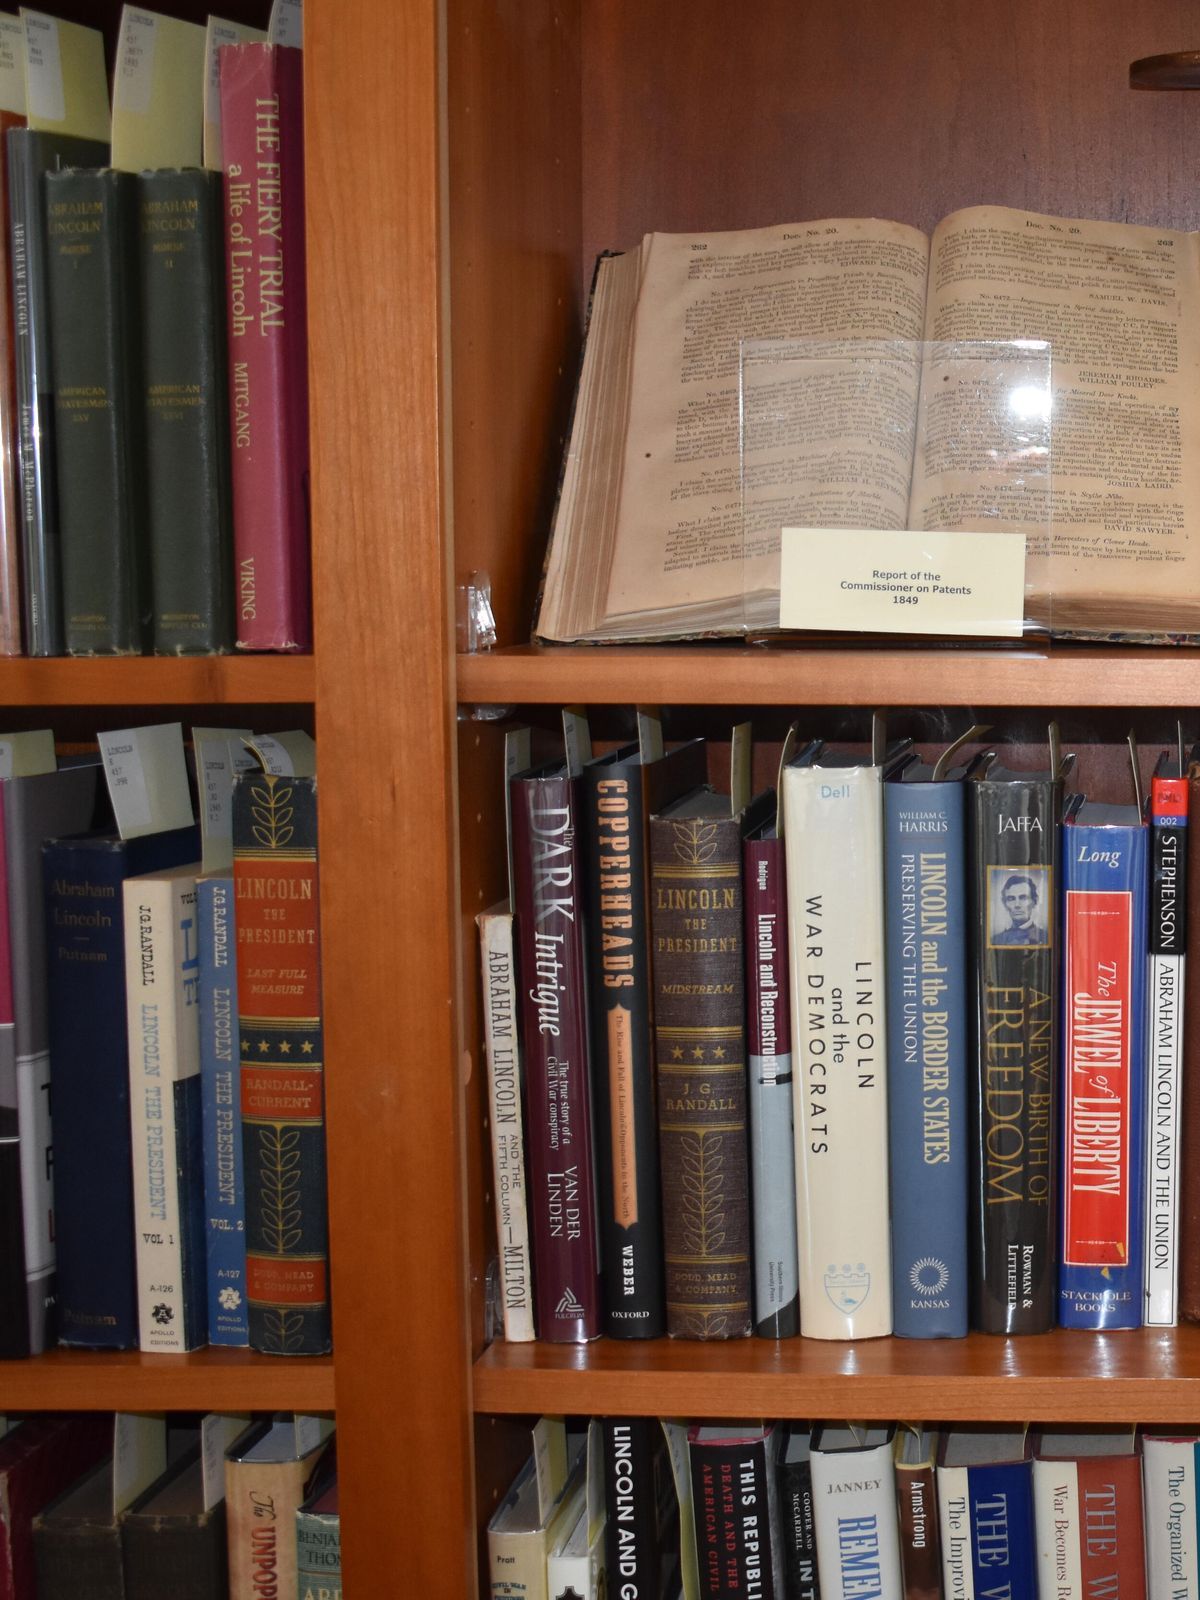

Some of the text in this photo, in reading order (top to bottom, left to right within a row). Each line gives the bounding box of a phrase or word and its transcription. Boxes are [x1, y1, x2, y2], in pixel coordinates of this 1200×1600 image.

[255, 94, 285, 337] THE FIERY TRIAL
[229, 164, 254, 337] a life of Lincoln
[234, 362, 251, 449] MITGANG
[240, 557, 256, 621] VIKING
[840, 580, 972, 595] Commissioner on Patents
[872, 570, 941, 582] Report of the
[892, 595, 919, 605] 1849
[820, 785, 851, 799] Dell
[998, 814, 1044, 835] JAFFA
[899, 820, 949, 833] HARRIS
[1077, 845, 1122, 868] Long
[53, 879, 115, 898] Abraham
[237, 878, 313, 900] LINCOLN
[263, 908, 286, 920] THE
[596, 779, 635, 988] COPPERHEADS
[657, 887, 736, 910] LINCOLN
[1160, 835, 1178, 949] STEPHENSON
[238, 928, 316, 945] PRESIDENT
[529, 800, 575, 1037] DARK Intrigue
[658, 937, 738, 952] PRESIDENT
[684, 918, 708, 930] THE
[661, 983, 735, 995] MIDSTREAM
[901, 853, 919, 1064] PRESERVING THE UNION
[1097, 960, 1118, 998] The
[489, 951, 517, 1125] ABRAHAM LINCOLN
[805, 895, 829, 1154] WAR DEMOCRATS
[831, 987, 851, 1064] and the
[855, 961, 876, 1089] LINCOLN
[920, 852, 951, 1166] LINCOLN and the BORDER STATES
[213, 987, 235, 1206] LINCOLN THE PRESIDENT
[559, 1060, 570, 1078] The
[560, 1080, 569, 1099] true
[986, 985, 1025, 1206] FREEDOM
[1072, 992, 1122, 1196] JEWEL of LIBERTY
[142, 1003, 167, 1221] LINCOLN THE PRESIDENT
[547, 1056, 561, 1151] Civil War conspiracy
[559, 1101, 571, 1124] story
[562, 1126, 573, 1137] of
[666, 1099, 737, 1111] RANDALL
[1154, 962, 1174, 1271] ABRAHAM LINCOLN AND THE UNION
[547, 1171, 564, 1238] LINDEN
[564, 1165, 582, 1242] VAN DER
[621, 1244, 635, 1296] WEBER
[611, 1310, 650, 1319] OXFORD
[910, 1299, 950, 1309] KANSAS
[613, 1425, 638, 1577] LINCOLN AND
[826, 1478, 883, 1495] JANNEY
[910, 1481, 927, 1549] Armstrong
[975, 1492, 1010, 1568] THE
[1053, 1485, 1070, 1582] War Becomes
[1085, 1483, 1117, 1558] THE
[1166, 1465, 1189, 1583] The Organized
